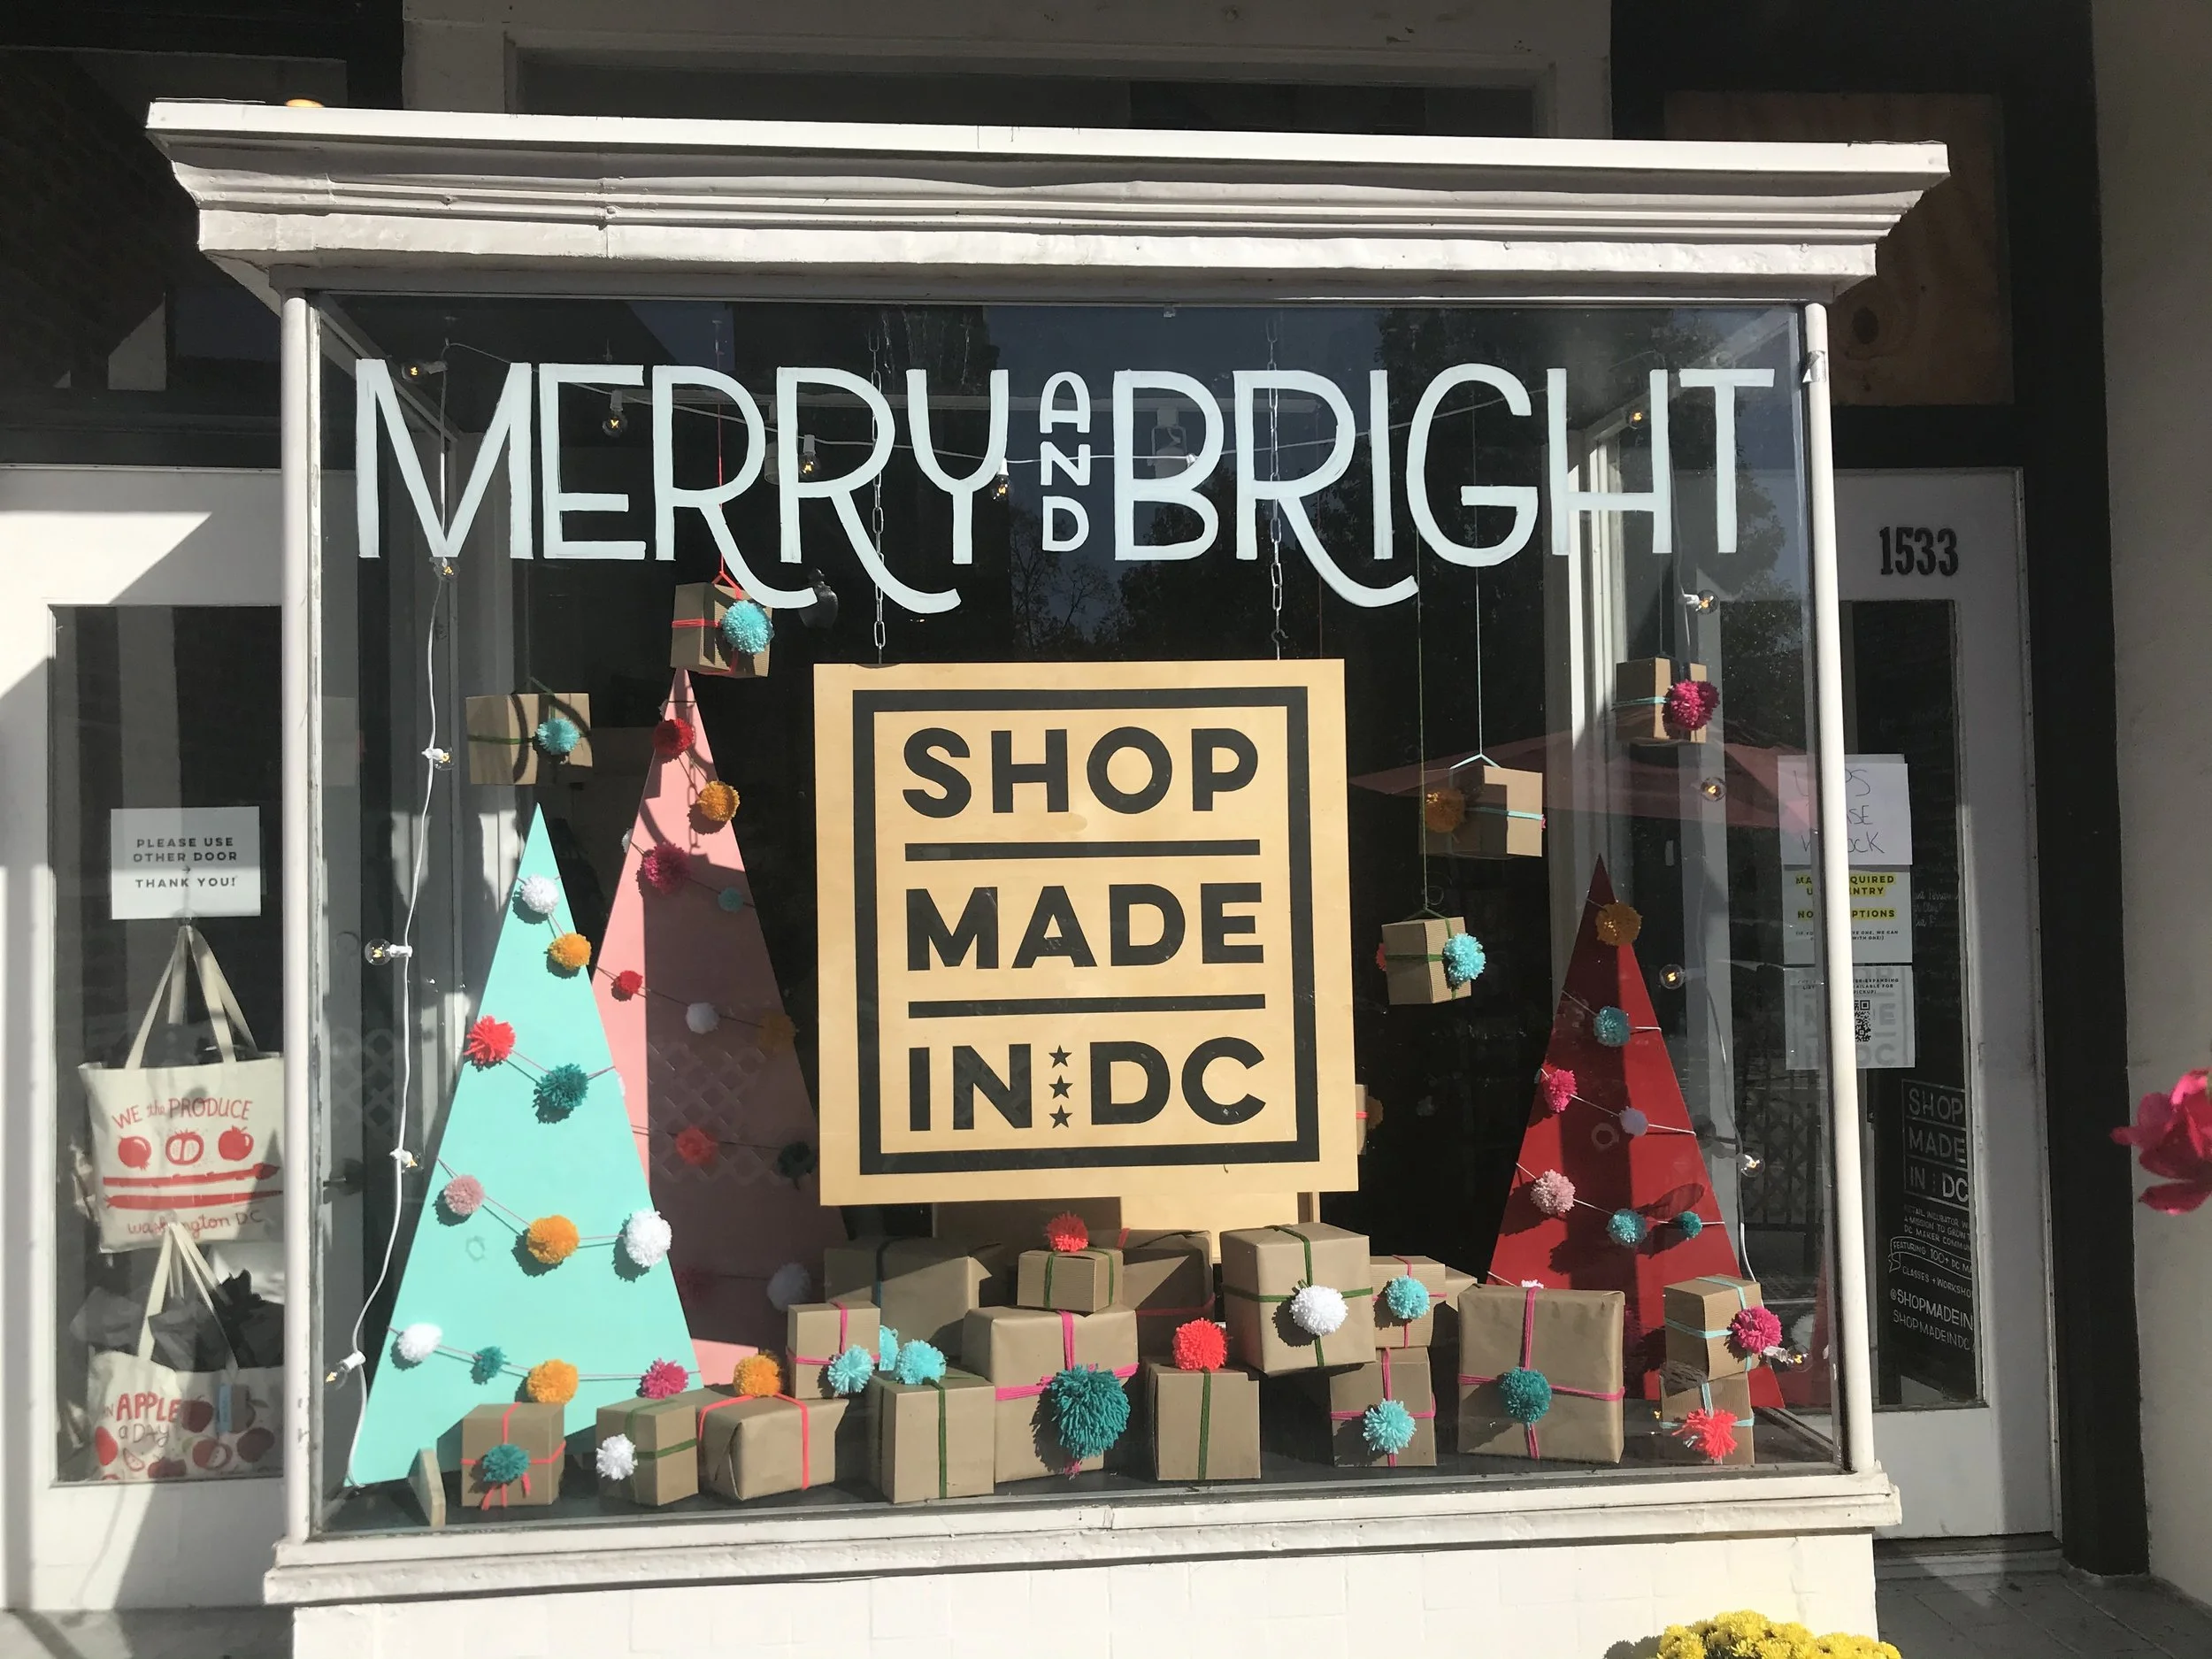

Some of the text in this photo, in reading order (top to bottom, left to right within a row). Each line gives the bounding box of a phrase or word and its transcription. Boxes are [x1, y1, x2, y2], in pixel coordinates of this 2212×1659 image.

[356, 358, 1775, 615] MERRY AND BRIGHT
[1879, 526, 1959, 576] 1533
[902, 726, 1258, 818] SHOP
[136, 837, 234, 849] PLEASE USE
[133, 851, 237, 863] OTHER DOOR
[135, 876, 236, 888] THANK YOU!
[1849, 875, 1895, 885] QUIRED
[1851, 910, 1896, 918] PTIONS
[906, 882, 1264, 972] MADE
[910, 1036, 1267, 1132] IN DC
[112, 1096, 254, 1129] WE the PRODUCE
[1909, 1087, 1963, 1122] SHOP
[1909, 1125, 1966, 1164] MADE
[1910, 1166, 1969, 1202] IN DC
[234, 1210, 264, 1225] DC
[1937, 1223, 1946, 1233] TO
[1904, 1224, 1913, 1234] DC
[1916, 1227, 1940, 1242] MAKER
[1893, 1240, 1926, 1256] FEATURING
[1902, 1265, 1930, 1283] CLASSES
[116, 1391, 182, 1423] APPLE
